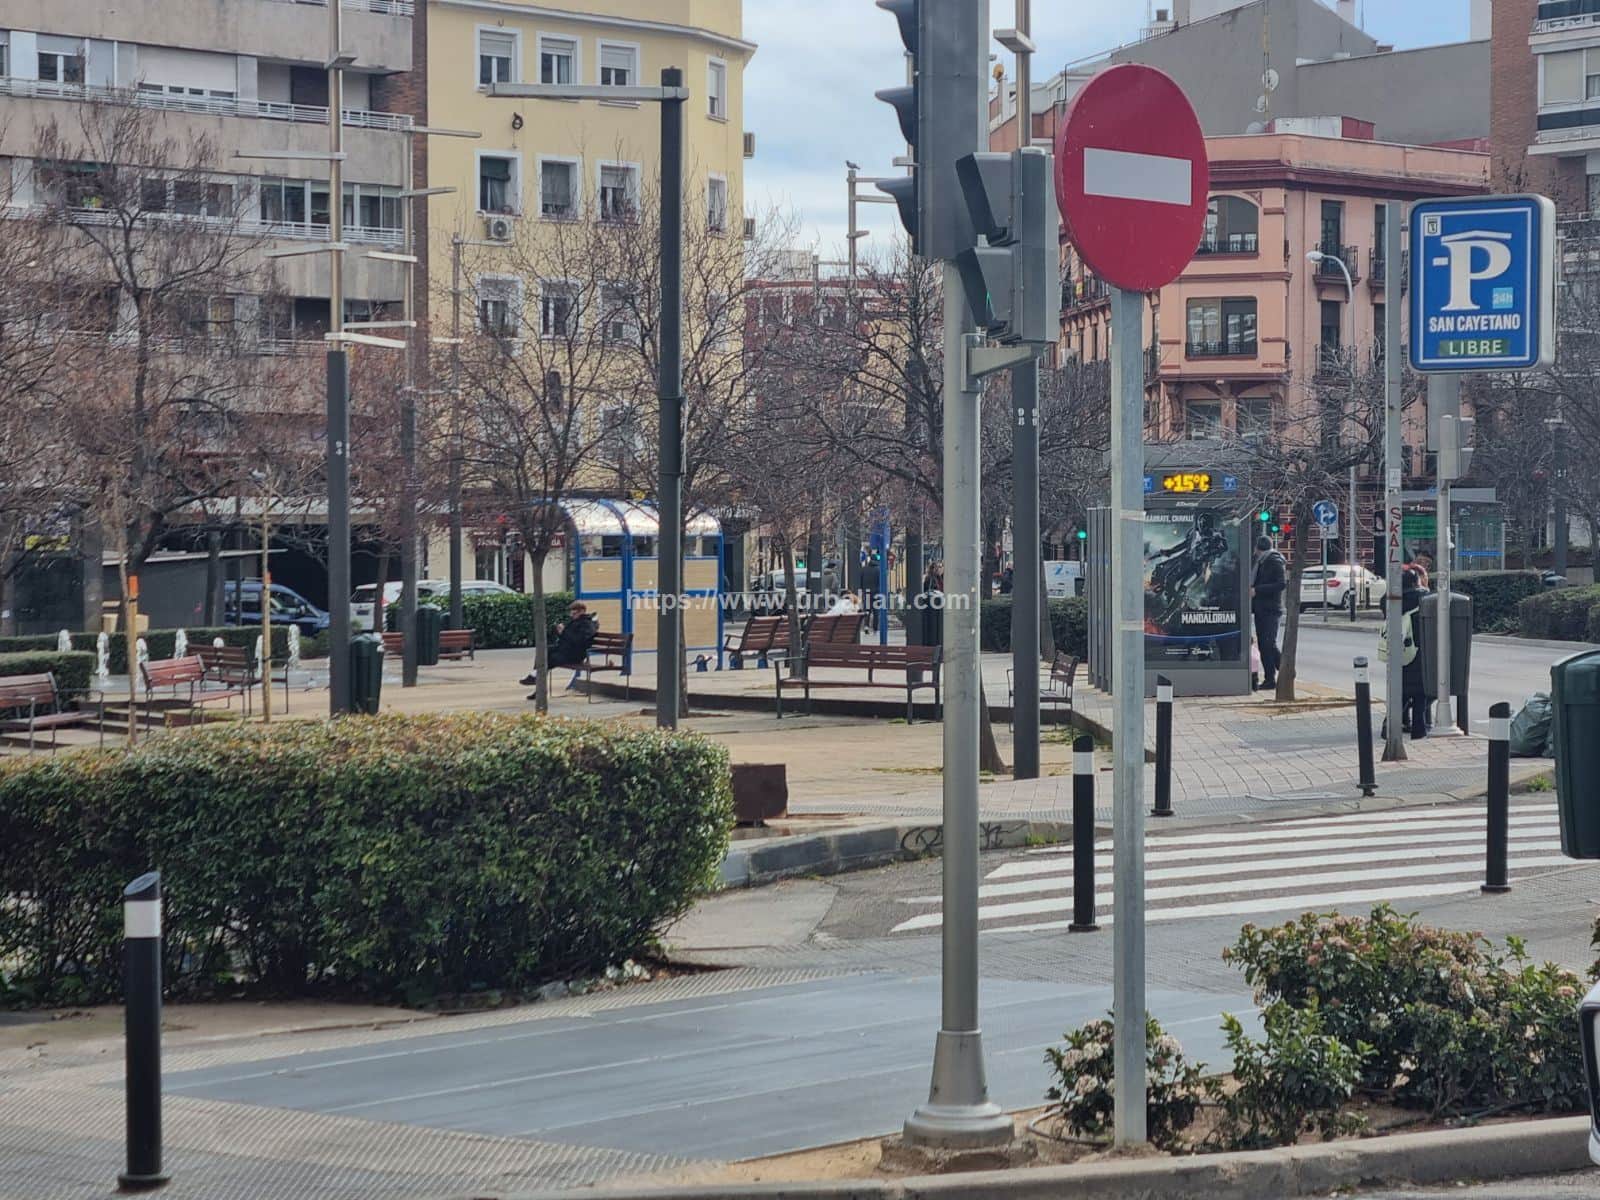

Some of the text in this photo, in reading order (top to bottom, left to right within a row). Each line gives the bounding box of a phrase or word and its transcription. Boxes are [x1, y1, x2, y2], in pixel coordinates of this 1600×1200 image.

[1441, 240, 1512, 311] P
[1429, 313, 1521, 333] SAN CAYETANO
[1449, 340, 1503, 356] LIBRE
[1181, 612, 1237, 624] MANDALORIAN
